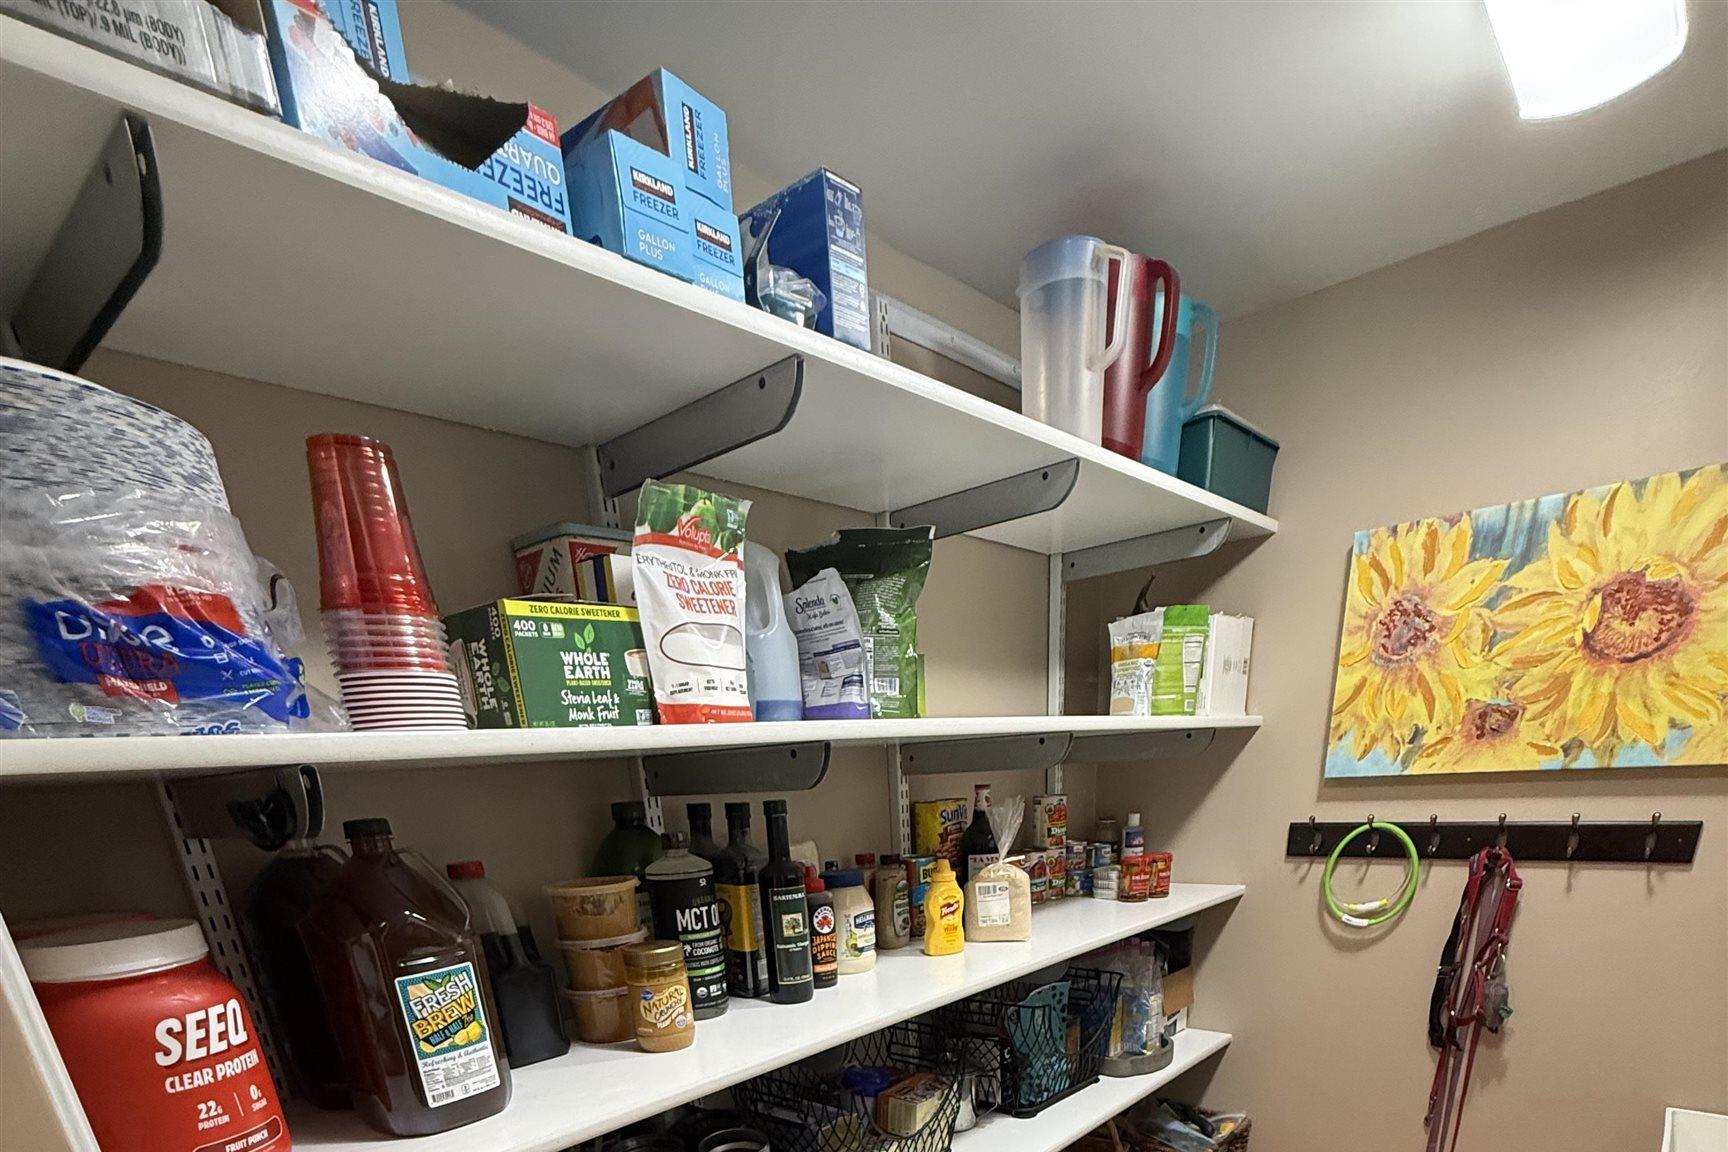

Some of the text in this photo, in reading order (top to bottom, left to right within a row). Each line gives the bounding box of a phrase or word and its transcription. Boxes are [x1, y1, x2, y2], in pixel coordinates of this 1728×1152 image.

[112, 20, 138, 44] MIL
[145, 15, 186, 47] (BODY)
[351, 0, 374, 66] REEZE
[367, 2, 390, 78] KIRKLAND
[682, 104, 696, 170] KIRKLAND
[694, 108, 708, 180] FREEZER
[713, 132, 725, 192] GALLON
[720, 158, 730, 194] PLUS
[478, 159, 566, 216] FREEZE
[632, 168, 675, 198] KIRKLAND
[633, 190, 680, 221] FREEZER
[637, 228, 677, 254] GALLON
[696, 221, 732, 246] KIRKLAND
[639, 242, 665, 262] PLUS
[697, 239, 736, 267] FREEZER
[699, 272, 731, 294] GALLON
[663, 570, 737, 597] ZERO CALORIE
[529, 604, 621, 618] ZERO CALORIE SWEETENER
[676, 592, 738, 617] SWEETENER
[490, 606, 501, 639] 400
[513, 619, 537, 631] 400
[560, 651, 610, 666] WHOLE
[471, 641, 491, 711] EARTH
[479, 638, 499, 711] WHOLE
[563, 666, 611, 680] EARTH
[560, 689, 620, 709] Stevia Leaf &
[569, 707, 595, 722] Monk
[597, 705, 620, 722] Fruit
[675, 906, 709, 932] MCT
[693, 945, 720, 957] COCONUTS
[409, 971, 474, 1020] FRESH
[411, 990, 476, 1040] BREW
[155, 998, 248, 1067] SEEQ
[165, 1049, 260, 1094] CLEAR PROTEIN
[198, 1114, 230, 1131] PROTEIN
[248, 1128, 269, 1146] PUNCH
